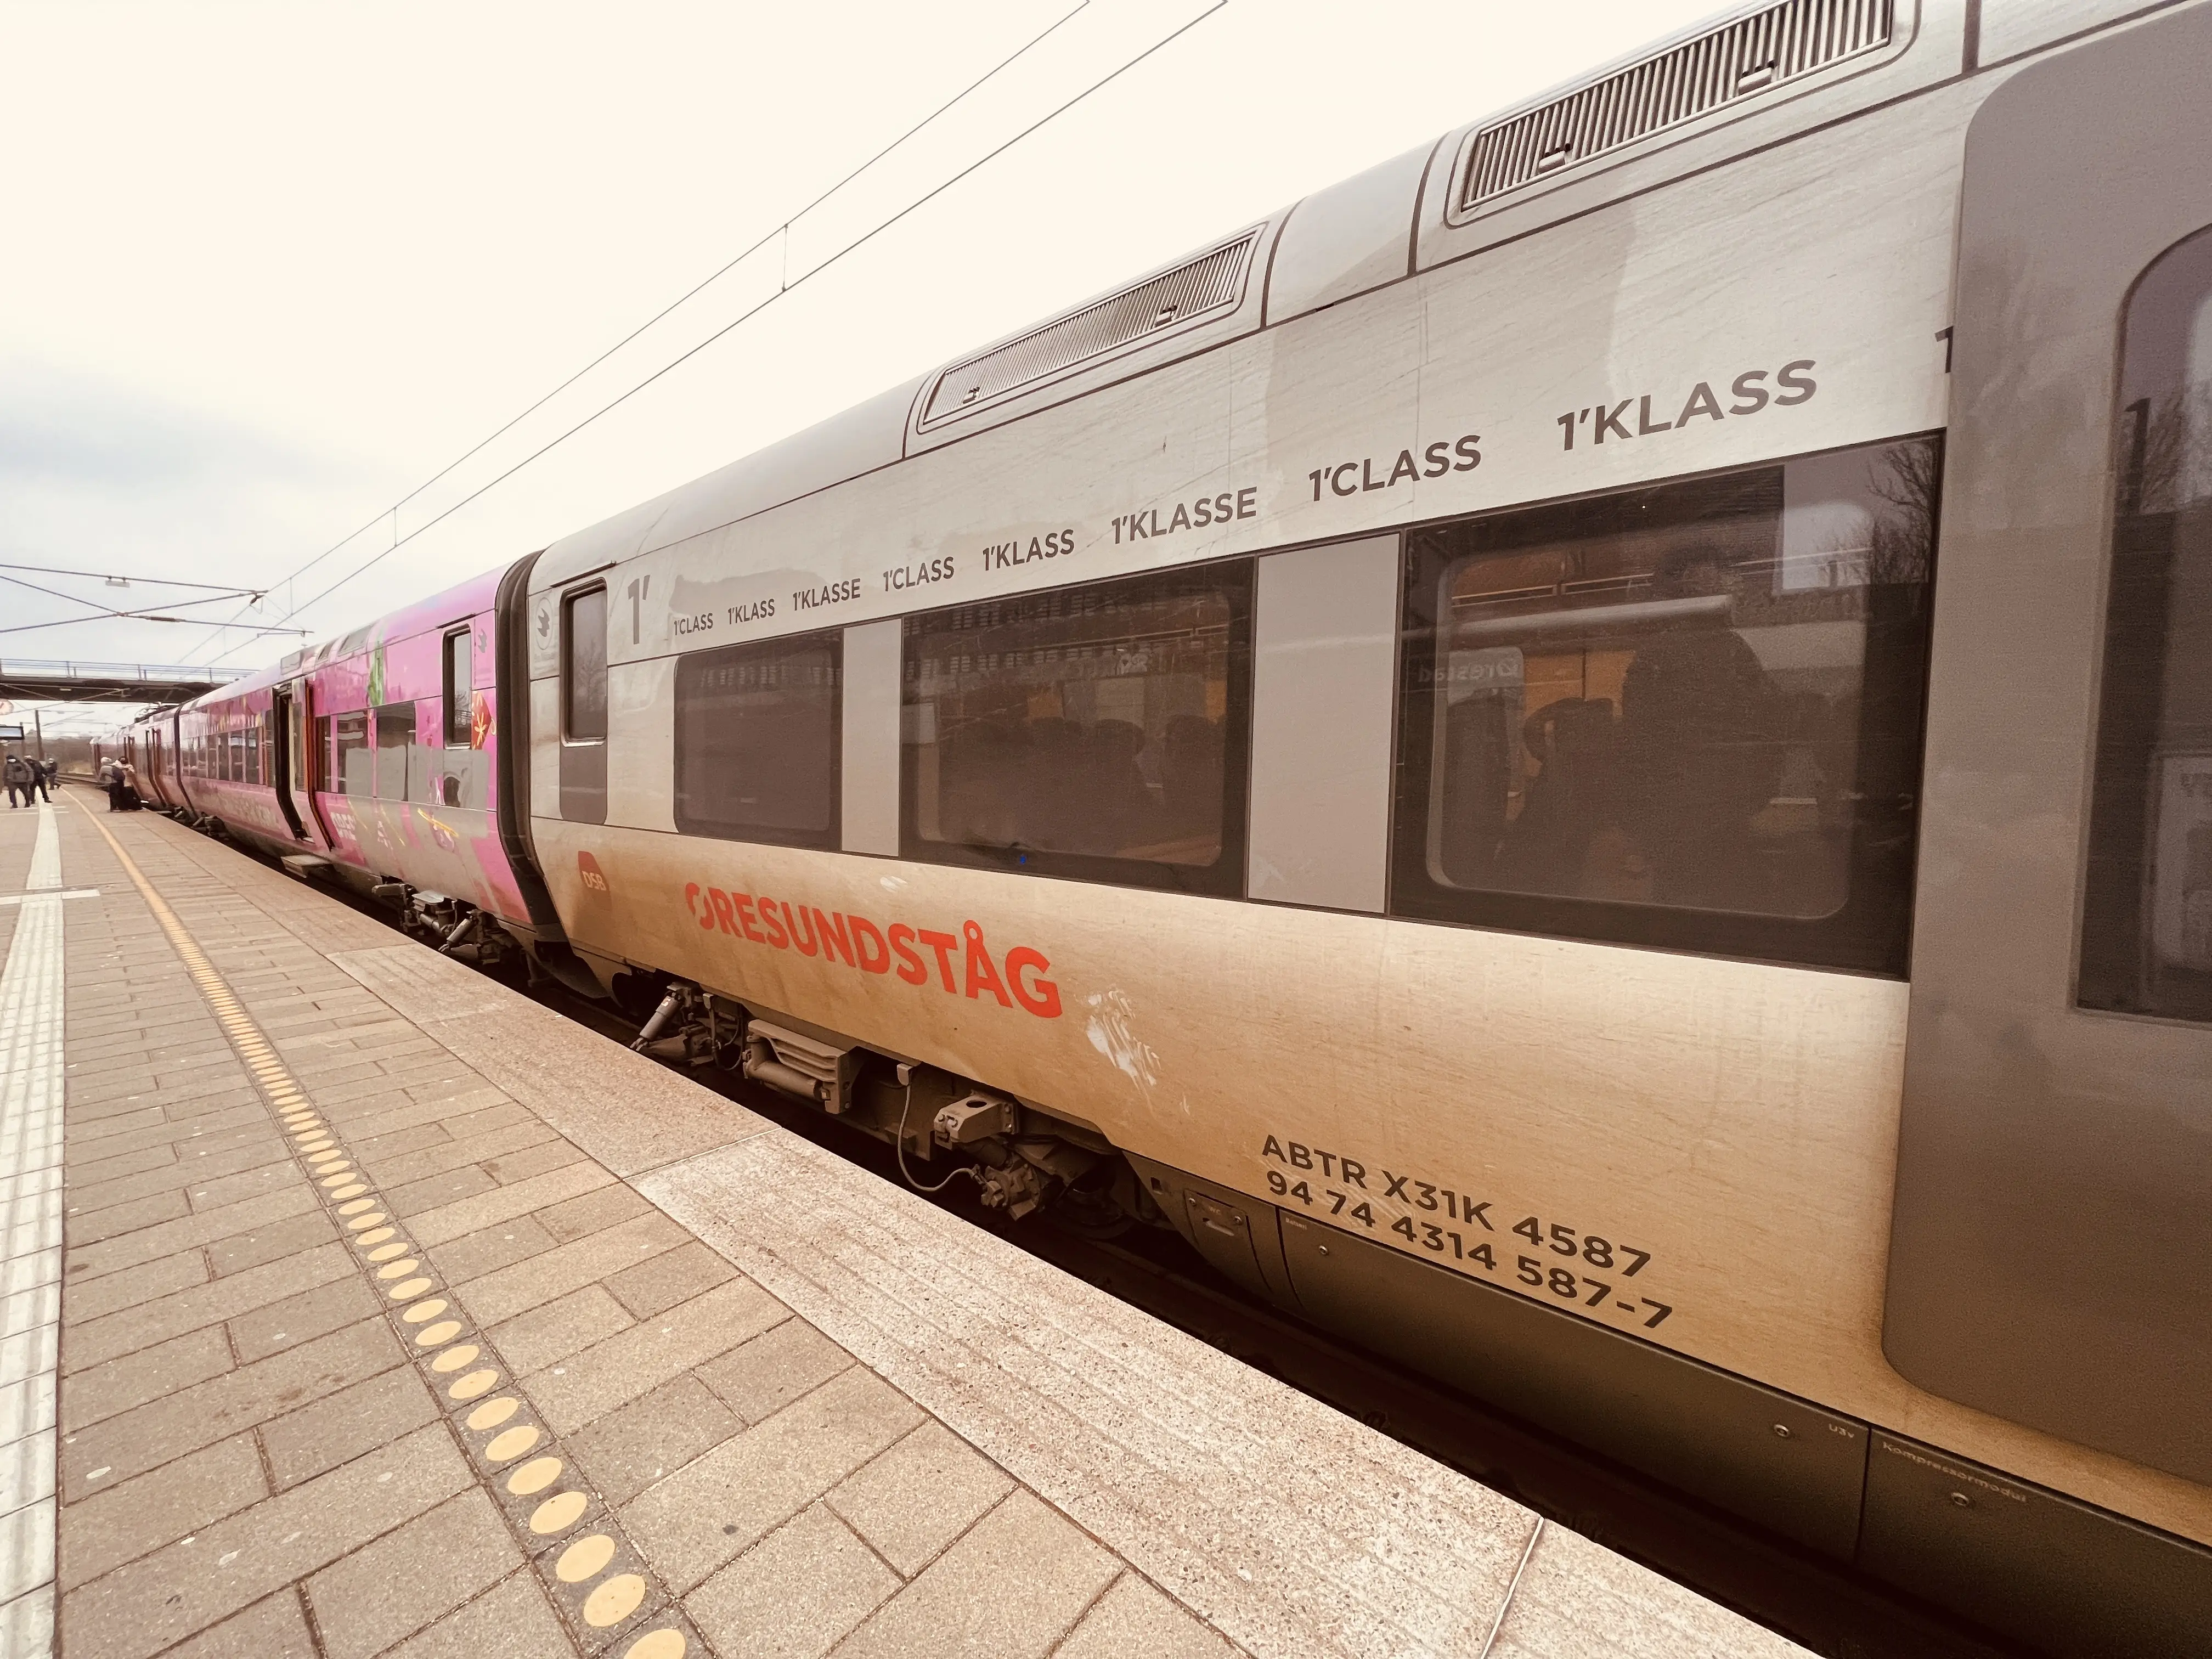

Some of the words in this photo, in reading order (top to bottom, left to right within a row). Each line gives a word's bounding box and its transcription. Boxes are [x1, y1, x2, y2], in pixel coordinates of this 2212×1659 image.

[674, 612, 713, 636] 1'CLASS
[727, 598, 775, 625] 1'KLASS
[792, 578, 861, 611] 1'KLASSE
[883, 556, 955, 592] 1'CLASS
[983, 529, 1074, 571] 1'KLASS
[1111, 486, 1257, 545] 1'KLASSE
[1308, 435, 1481, 502] 1'CLASS
[1556, 359, 1816, 452] 1'KLASS
[582, 871, 607, 891] DSB
[685, 882, 1063, 1018] ØRESUNDSTÅG
[1262, 1134, 1368, 1190] ABTR
[1381, 1170, 1495, 1232] X31K
[1512, 1216, 1651, 1278] 4587
[1267, 1170, 1313, 1206] 94
[1326, 1189, 1376, 1228] 74
[1391, 1216, 1497, 1271] 4314
[1516, 1255, 1673, 1329] 587-7
[1882, 1441, 2026, 1503] Kompressormodul
